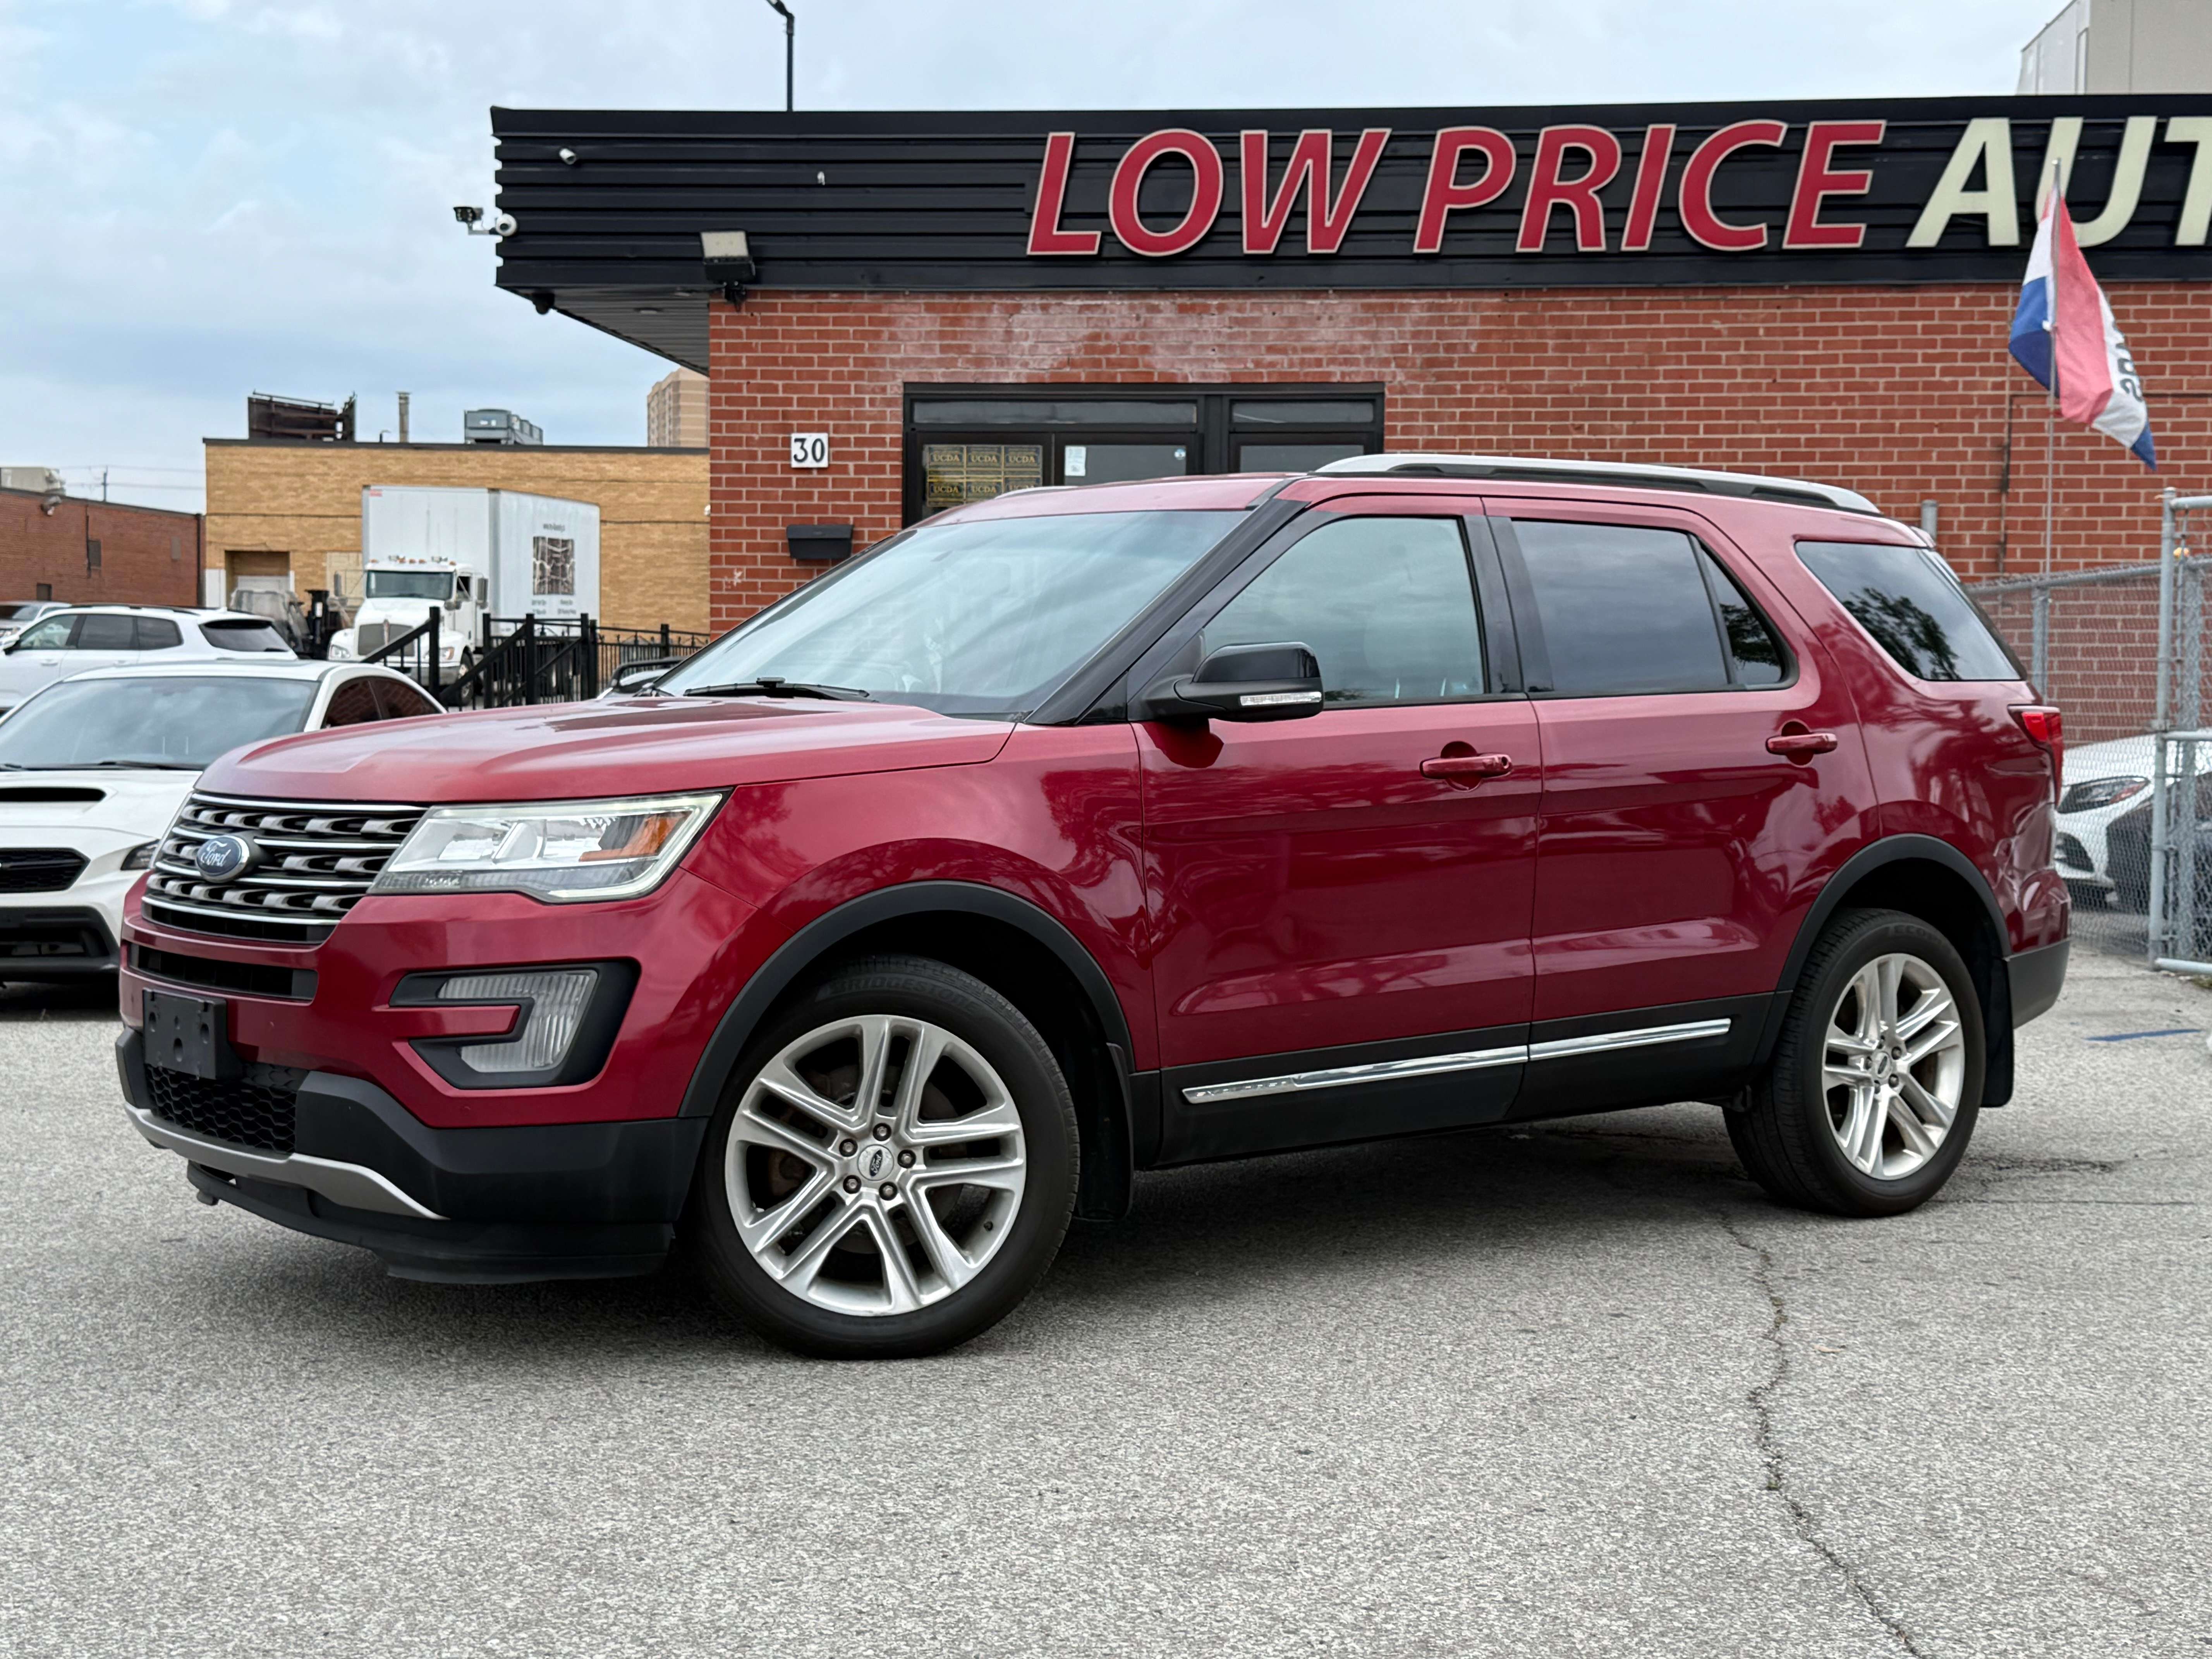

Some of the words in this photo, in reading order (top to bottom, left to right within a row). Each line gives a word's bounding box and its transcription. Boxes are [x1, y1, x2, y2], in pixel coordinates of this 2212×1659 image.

[1027, 128, 1392, 256] LOW
[1413, 120, 1887, 252] PRICE
[793, 438, 825, 462] 30
[201, 841, 231, 867] Ford
[871, 1154, 882, 1173] Ford
